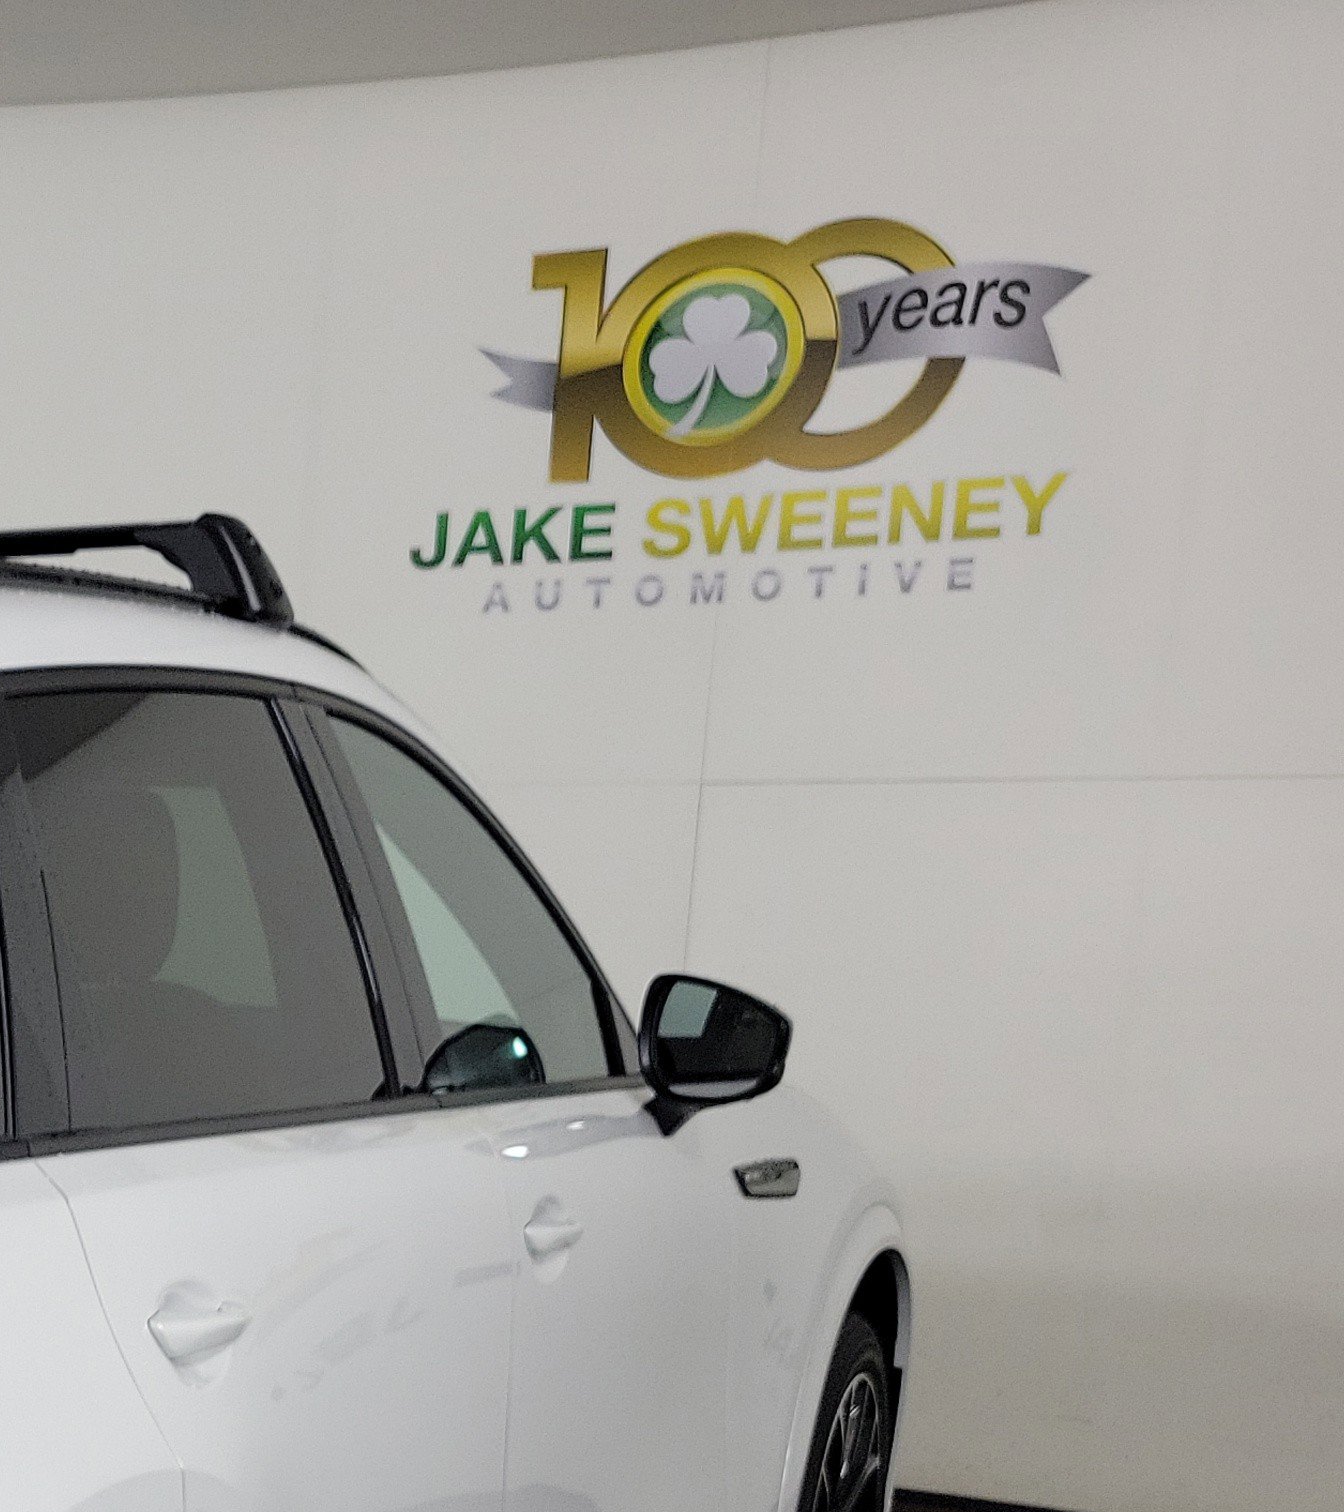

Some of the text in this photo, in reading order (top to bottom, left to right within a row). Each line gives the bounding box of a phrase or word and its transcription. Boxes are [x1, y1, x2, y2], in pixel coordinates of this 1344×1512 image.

[531, 216, 1032, 484] 100 years
[409, 471, 1069, 571] JAKE SWEENEY
[482, 557, 976, 615] AUTOMOTIVE
